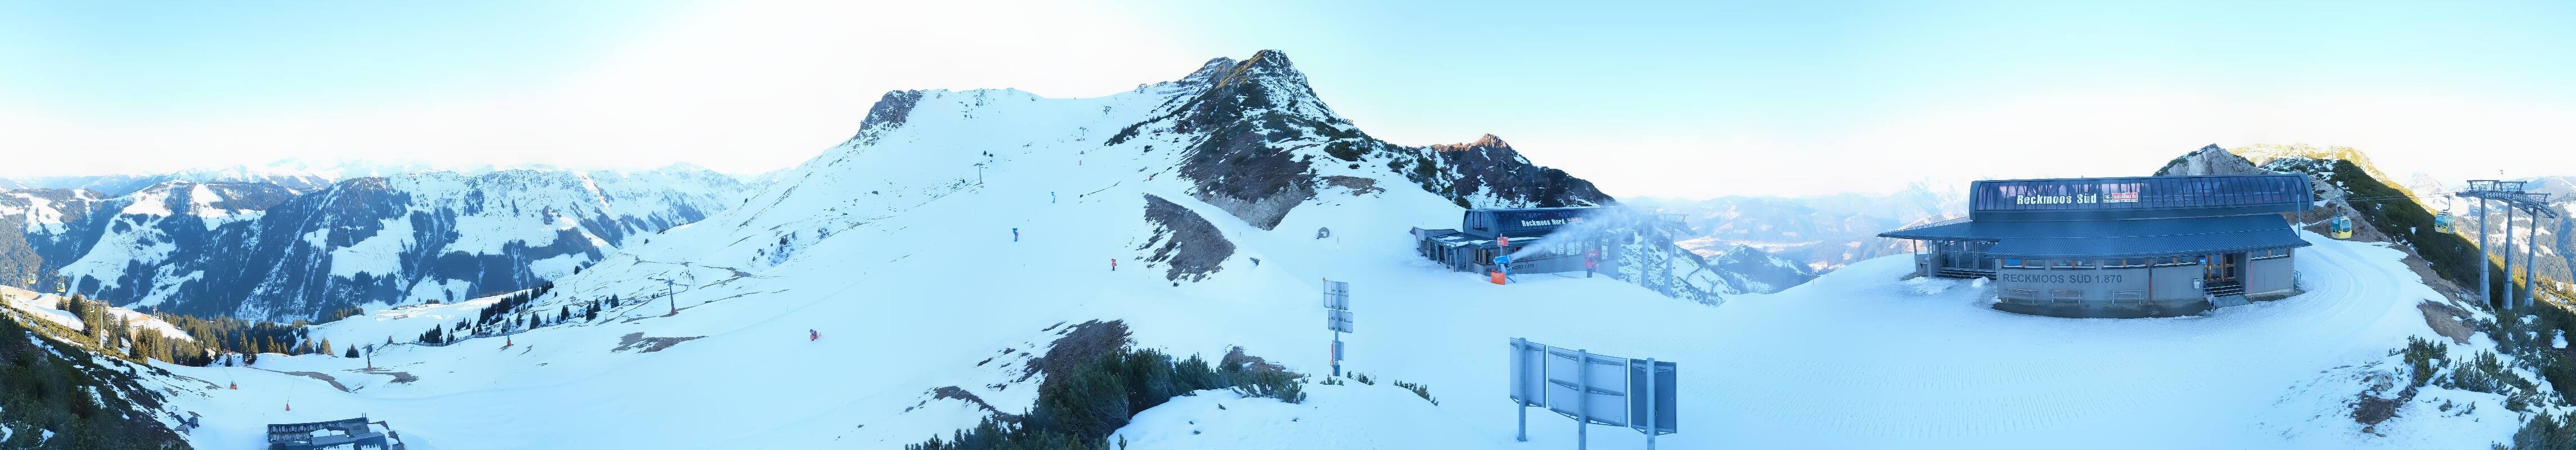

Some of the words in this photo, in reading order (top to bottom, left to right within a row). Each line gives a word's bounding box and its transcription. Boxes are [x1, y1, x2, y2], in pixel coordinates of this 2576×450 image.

[2017, 195, 2072, 205] Reckmoos
[2077, 194, 2097, 204] Süd
[2003, 273, 2064, 283] RECKMOOS
[2070, 274, 2092, 283] SÜD
[2095, 274, 2122, 283] 1.870
